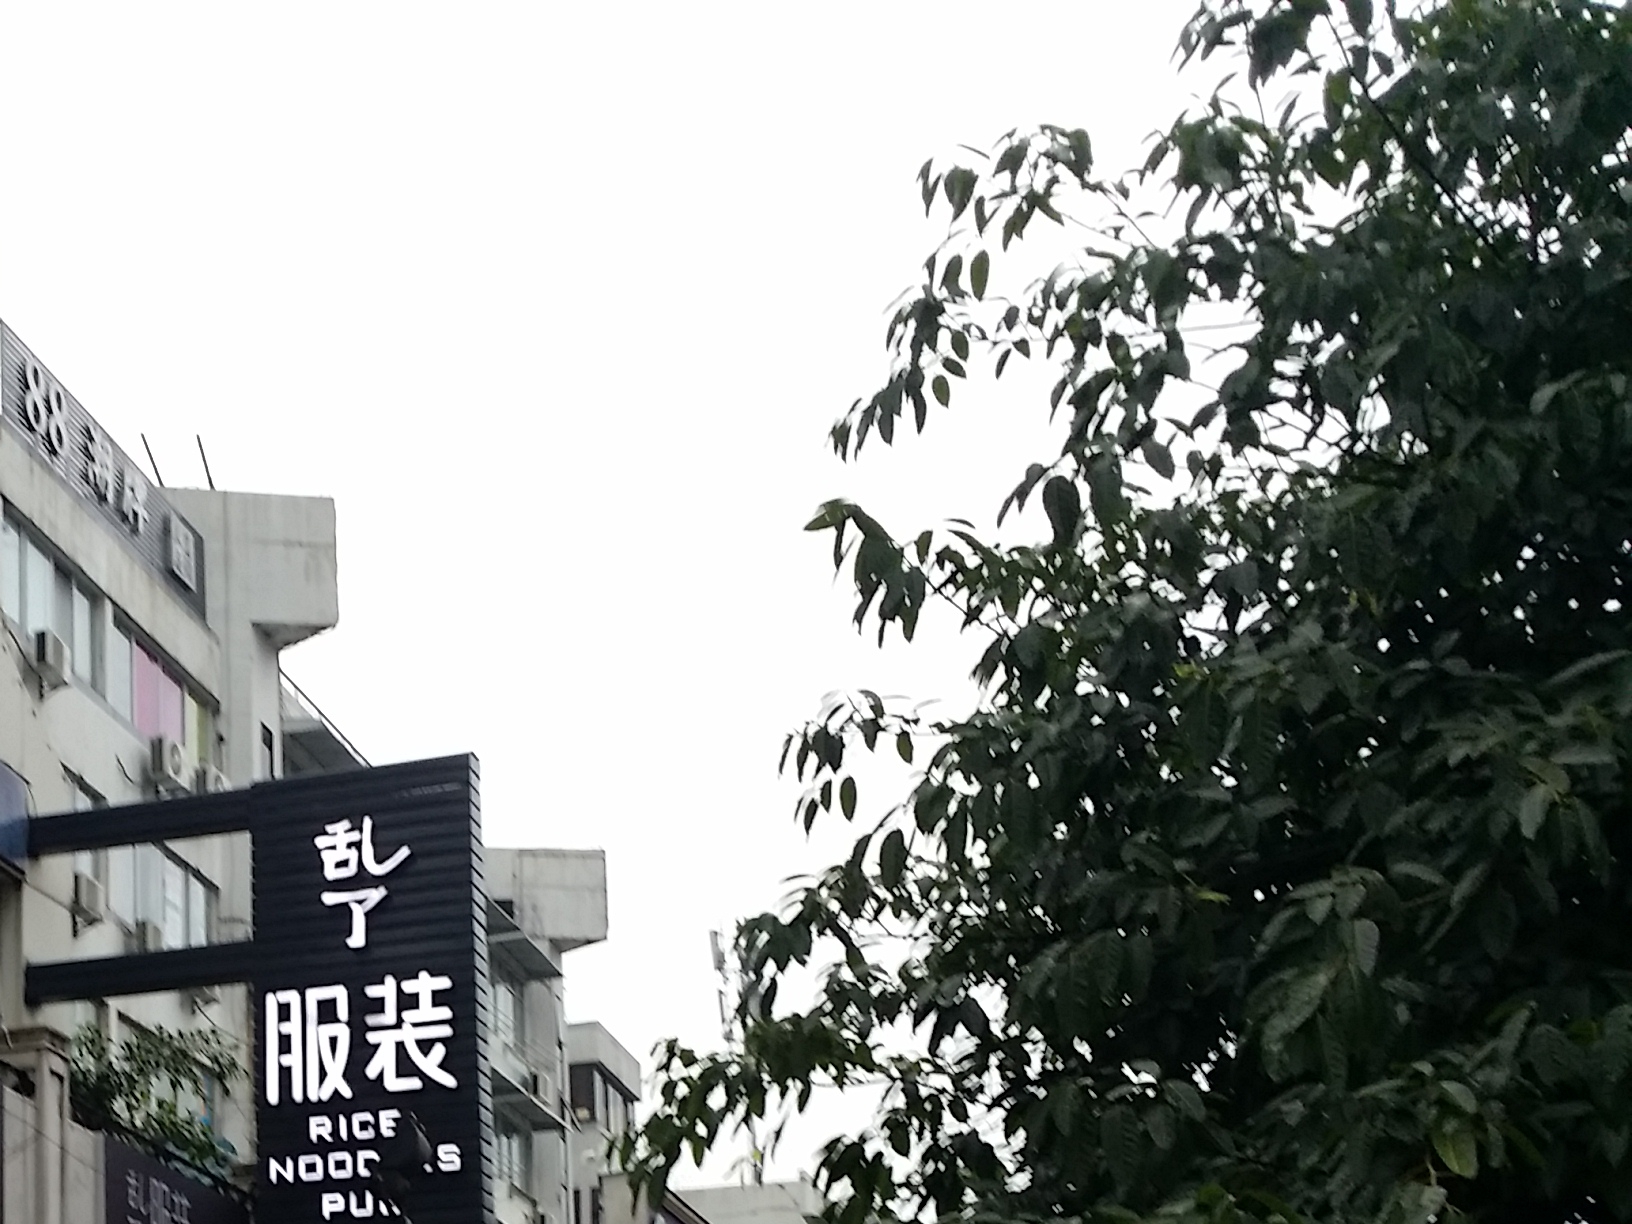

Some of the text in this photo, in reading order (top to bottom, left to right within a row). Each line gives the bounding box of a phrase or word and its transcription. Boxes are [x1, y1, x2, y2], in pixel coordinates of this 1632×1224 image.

[314, 815, 412, 949] 乱了
[265, 970, 459, 1107] 服装
[268, 1142, 462, 1186] NOODS
[308, 1108, 402, 1145] RICE
